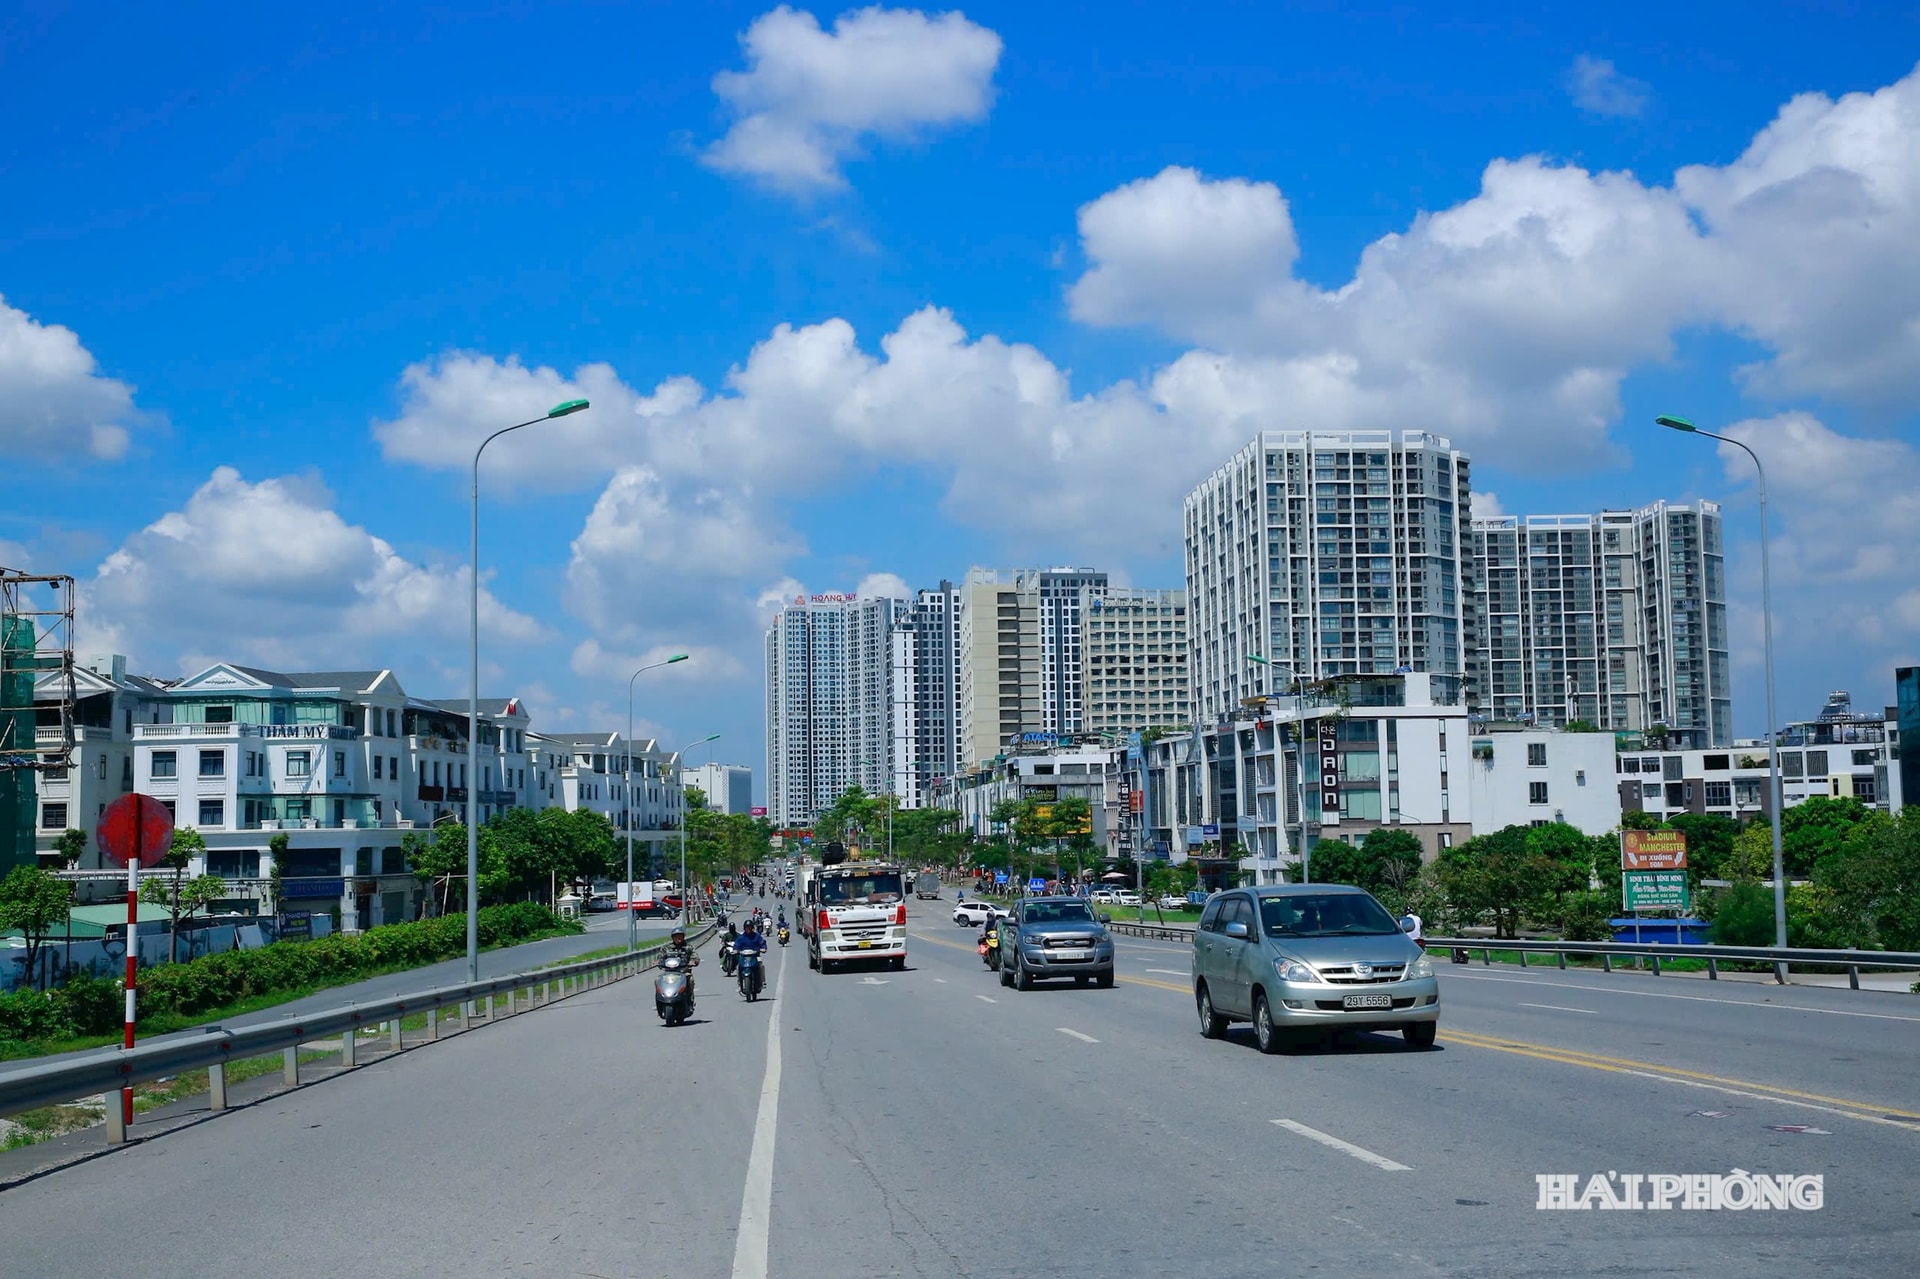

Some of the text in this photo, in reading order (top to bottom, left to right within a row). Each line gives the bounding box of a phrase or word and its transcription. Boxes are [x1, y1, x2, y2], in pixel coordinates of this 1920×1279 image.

[1321, 726, 1336, 735] 다온
[1024, 733, 1057, 742] ATACO
[1646, 832, 1676, 841] STADIUM
[1639, 843, 1685, 851] MANCHESTER
[1346, 996, 1389, 1006] 29Y 5556
